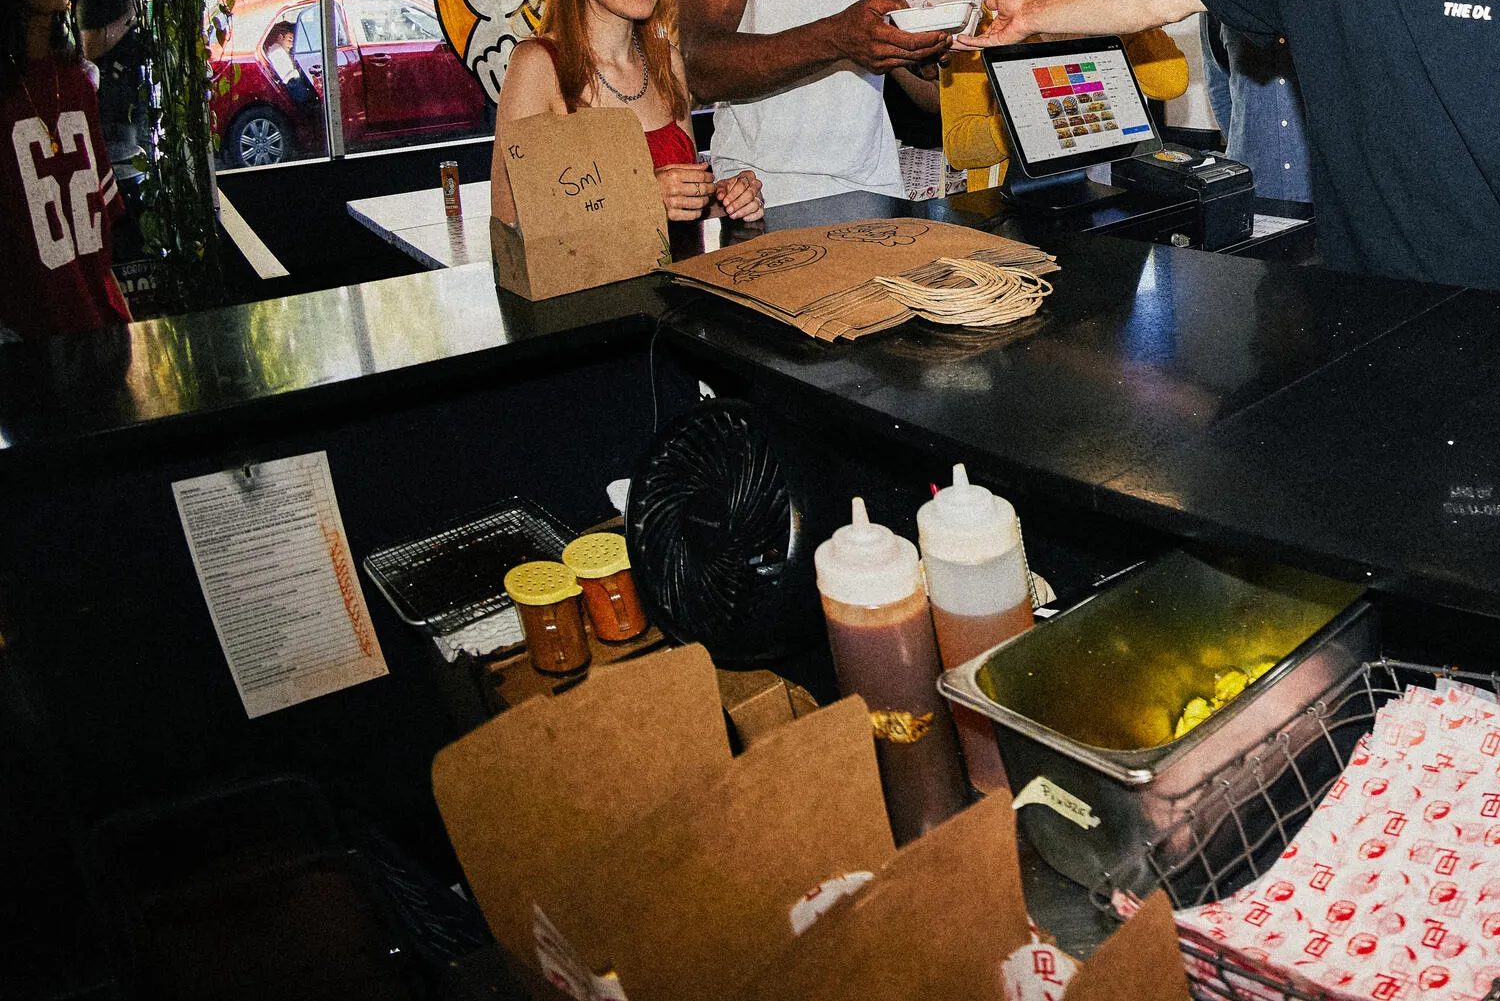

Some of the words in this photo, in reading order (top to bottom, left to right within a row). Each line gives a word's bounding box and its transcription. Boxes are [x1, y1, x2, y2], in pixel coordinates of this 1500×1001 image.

[1443, 1, 1473, 19] THE
[1471, 4, 1492, 21] DL
[12, 110, 103, 270] 62
